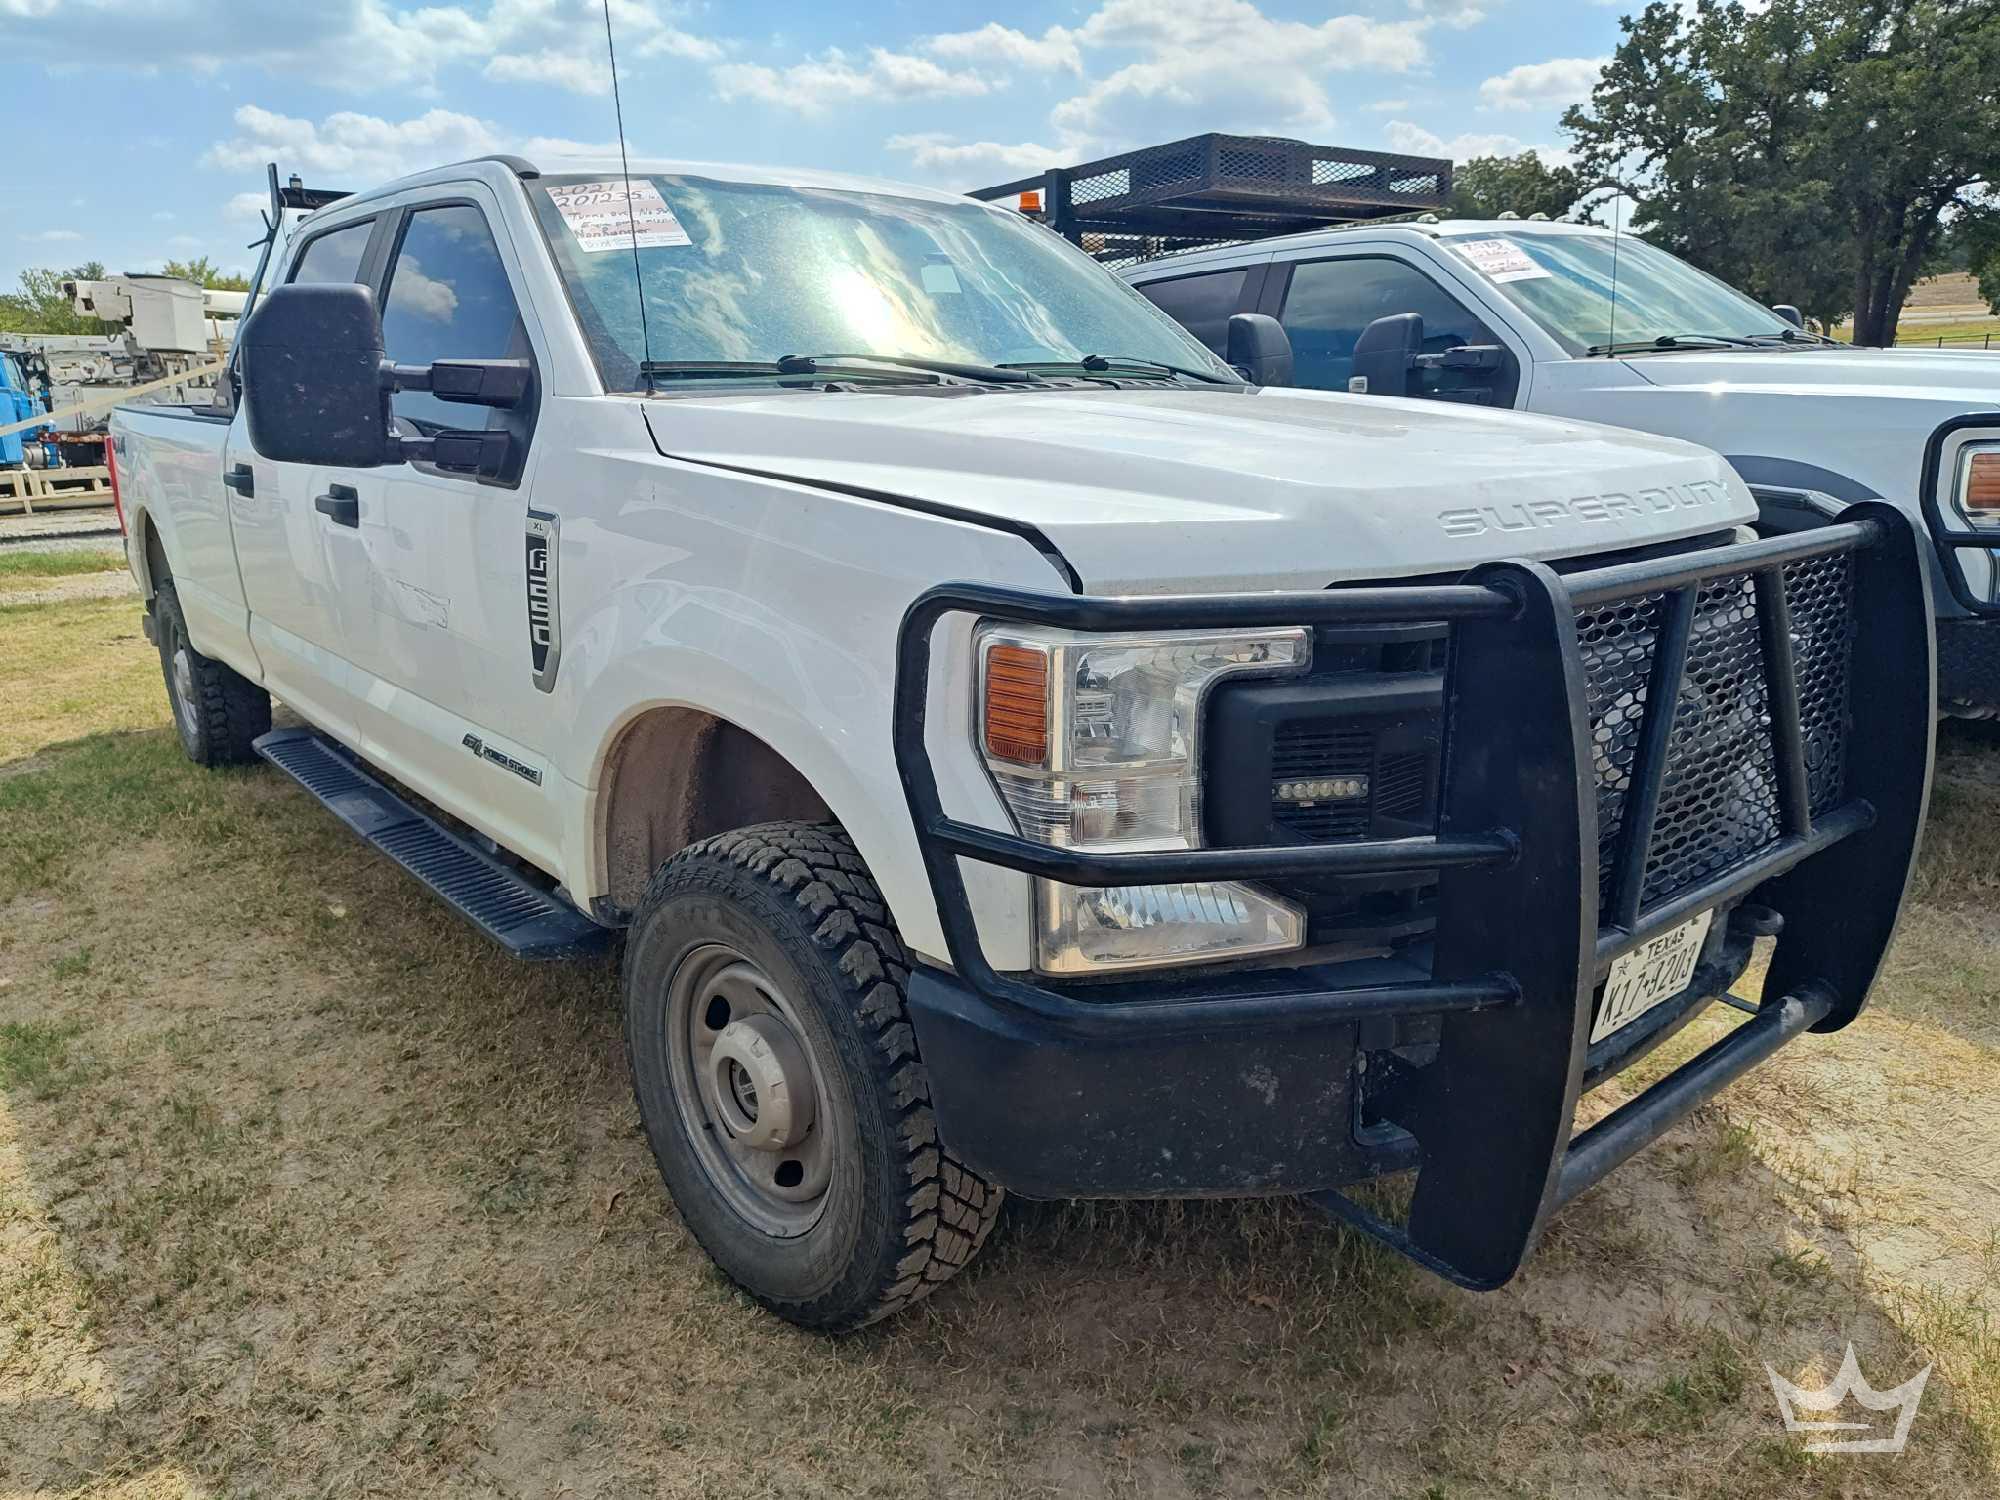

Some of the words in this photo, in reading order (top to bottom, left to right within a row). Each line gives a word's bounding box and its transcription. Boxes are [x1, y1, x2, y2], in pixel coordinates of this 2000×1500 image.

[553, 183, 615, 197] 2021
[1437, 493, 1642, 538] SUPER
[1640, 478, 1733, 514] DUTY
[533, 521, 544, 532] XL
[1647, 926, 1686, 960] TEXAS
